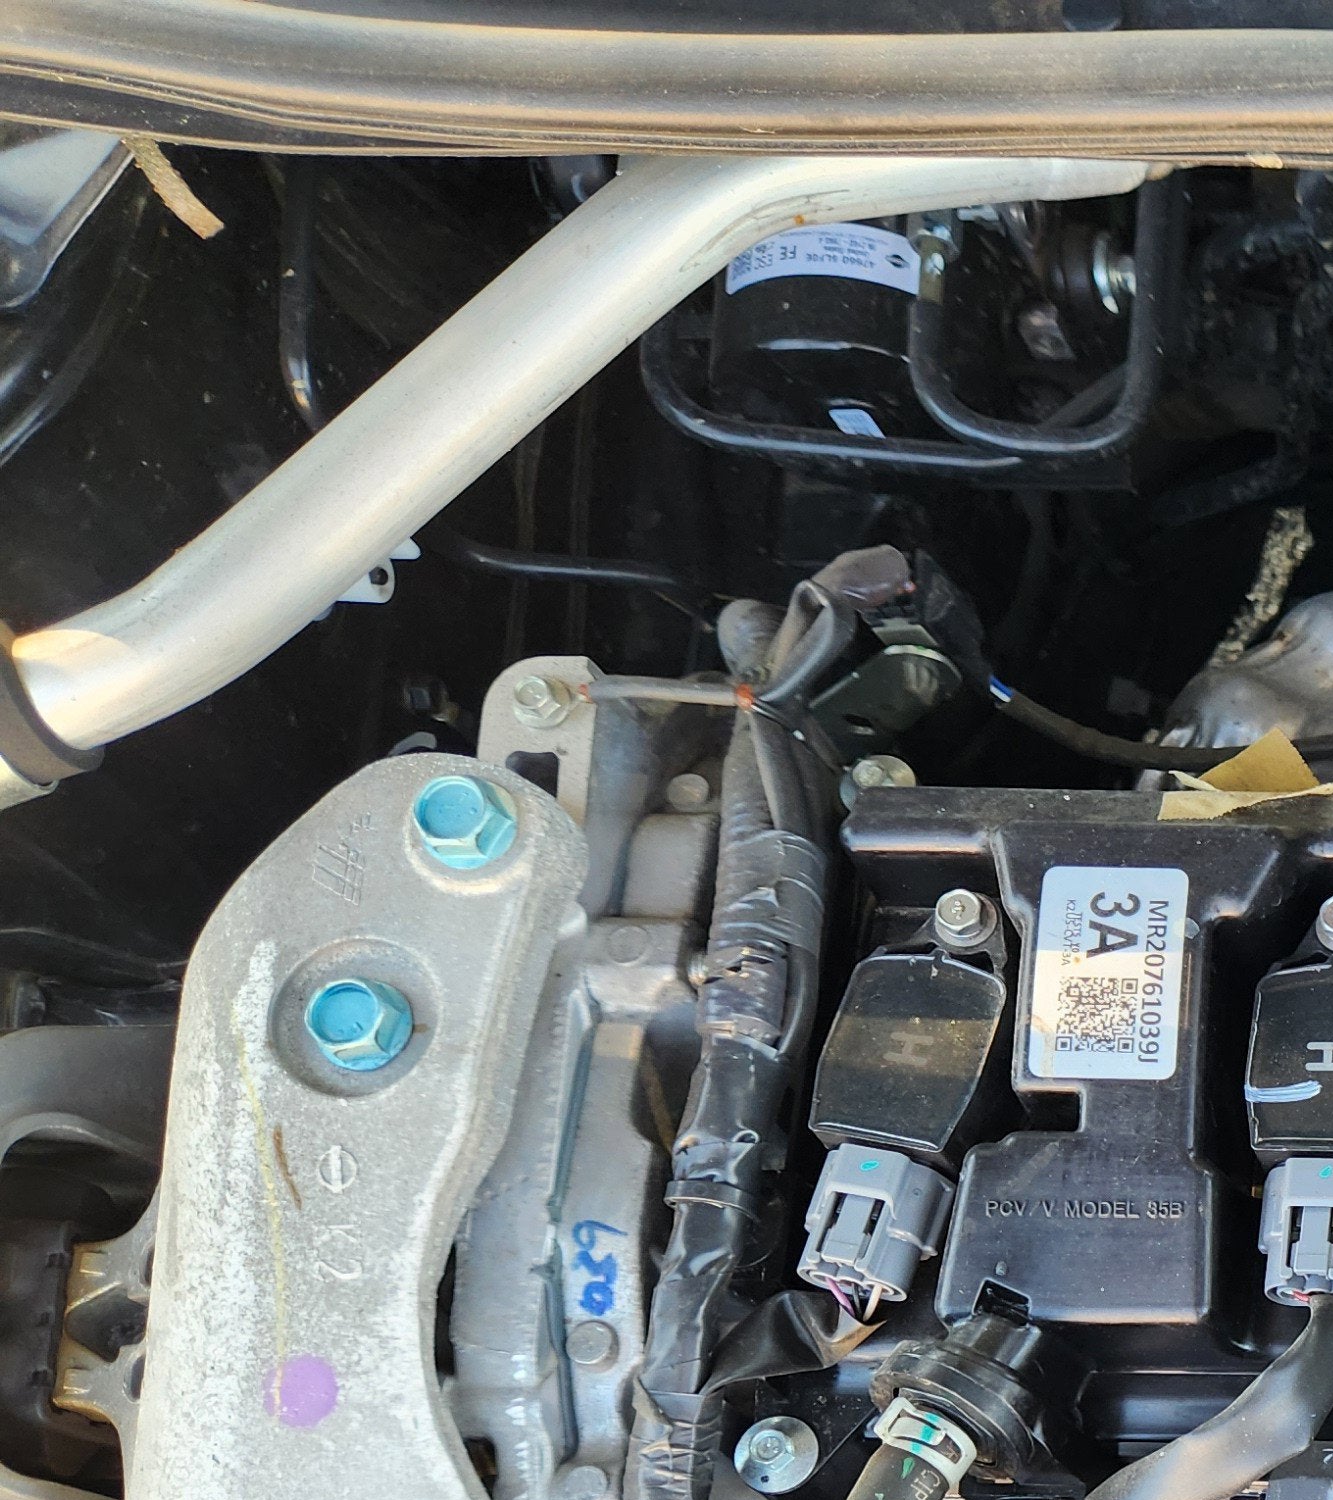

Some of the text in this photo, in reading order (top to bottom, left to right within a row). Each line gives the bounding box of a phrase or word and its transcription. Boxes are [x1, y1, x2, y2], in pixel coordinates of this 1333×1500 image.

[1085, 890, 1142, 960] 3A
[1137, 899, 1170, 1064] MR20761039J
[1063, 1200, 1141, 1219] MODEL
